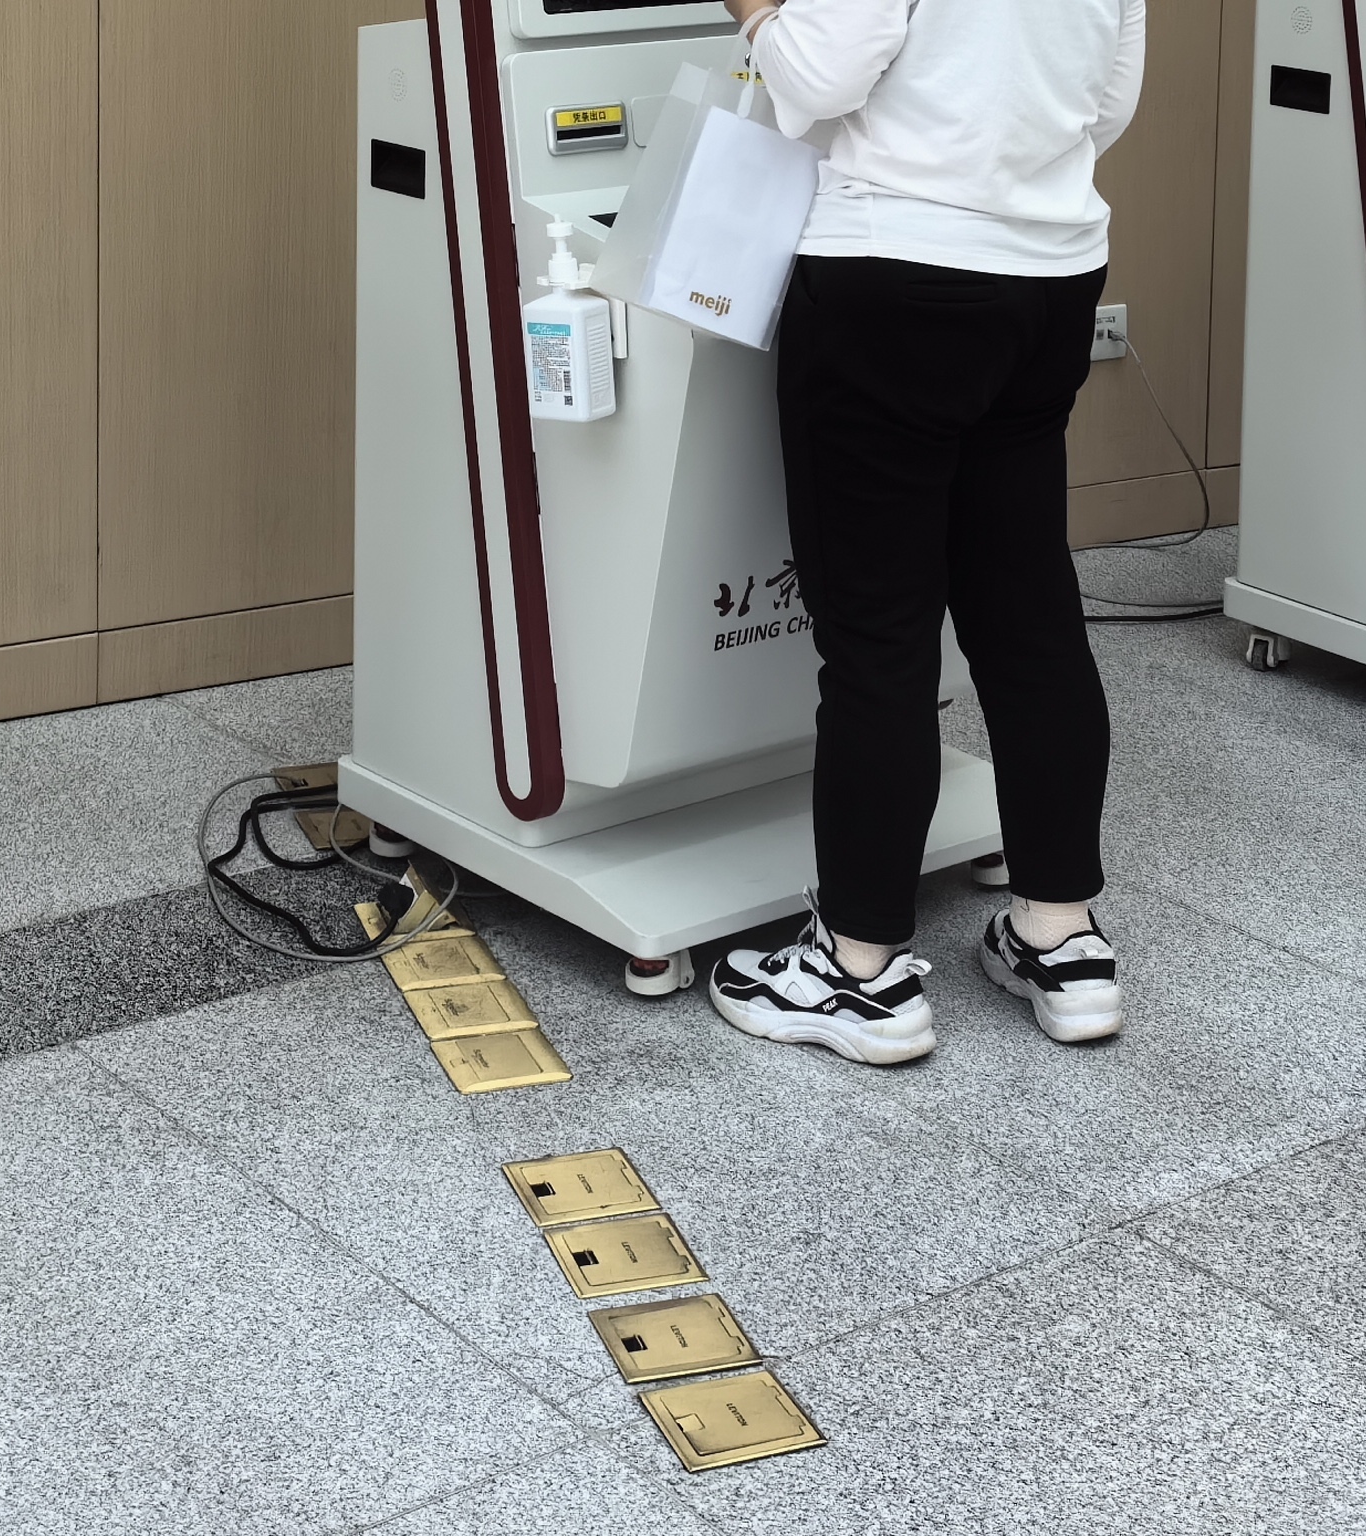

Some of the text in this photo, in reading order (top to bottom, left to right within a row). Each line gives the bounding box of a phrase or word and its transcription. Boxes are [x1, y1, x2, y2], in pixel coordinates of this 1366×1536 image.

[689, 291, 732, 316] meiji
[714, 615, 814, 651] BEIJING CH
